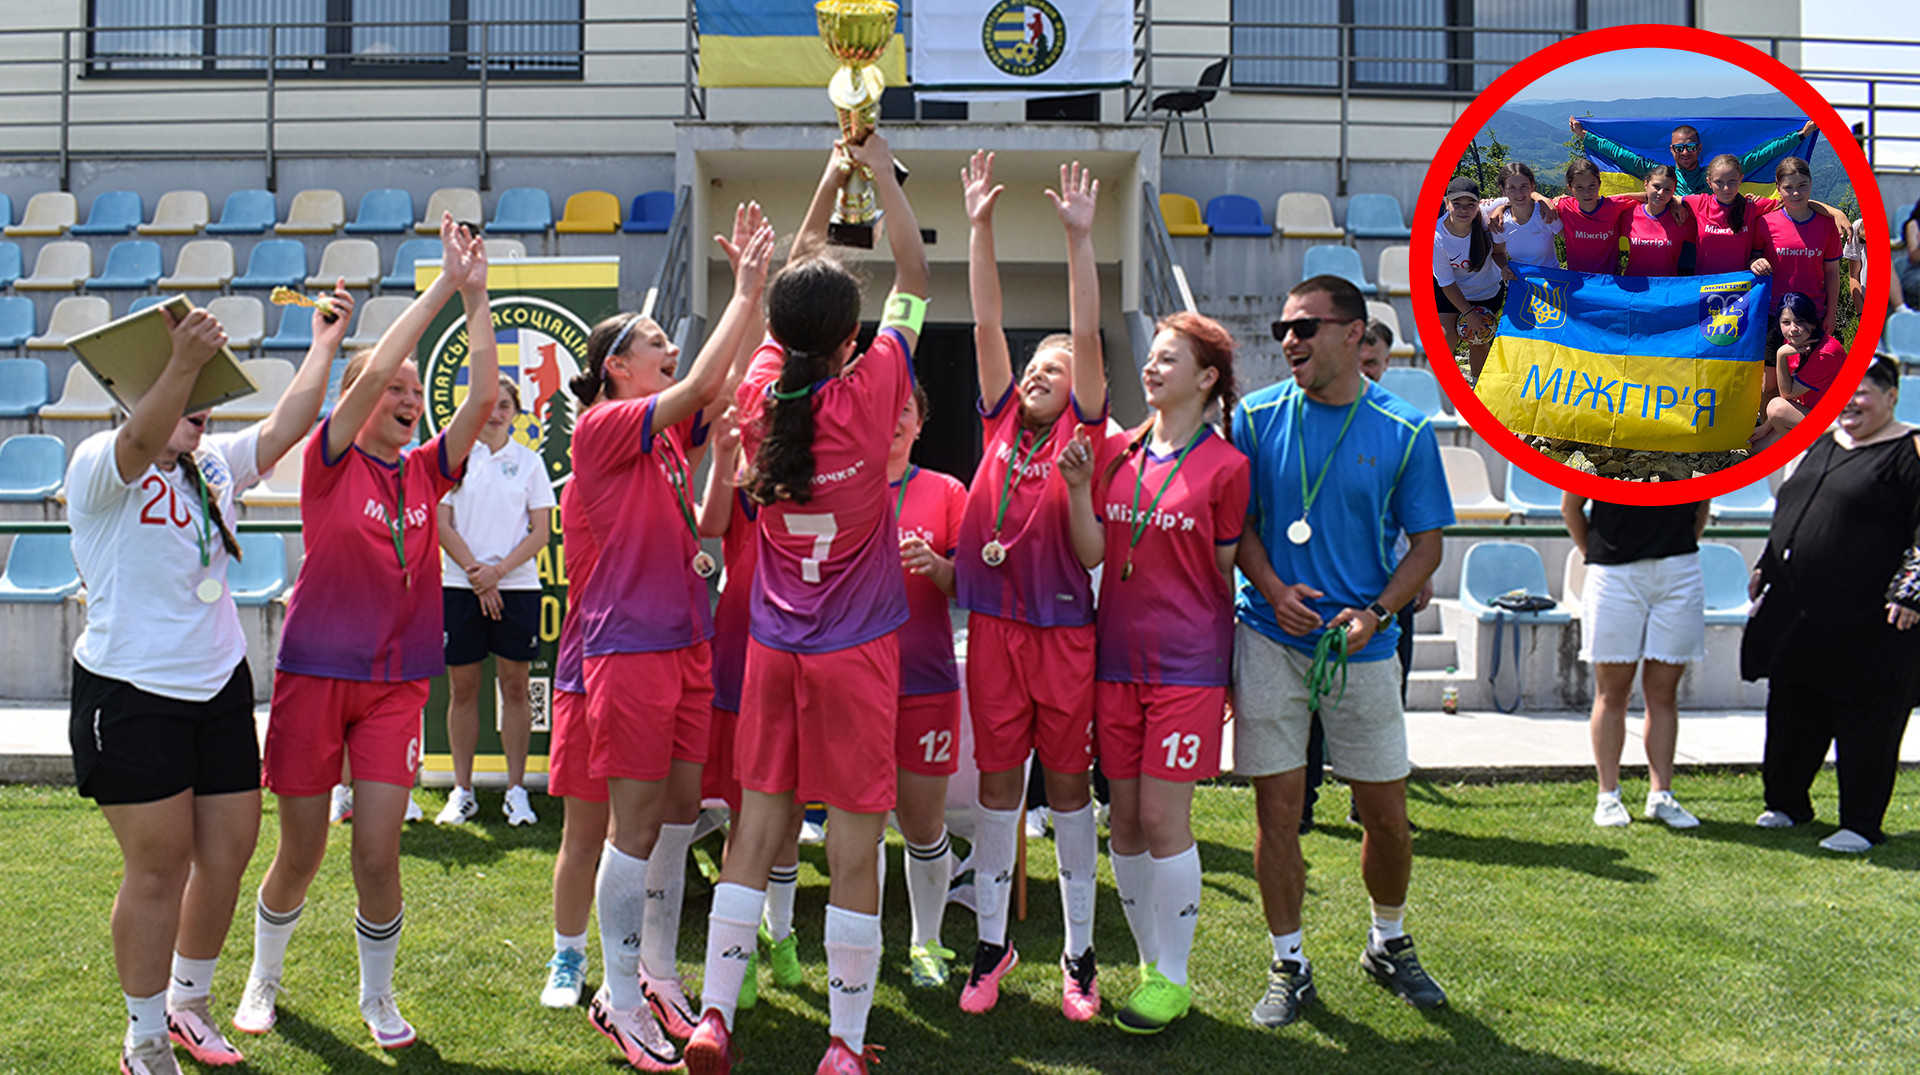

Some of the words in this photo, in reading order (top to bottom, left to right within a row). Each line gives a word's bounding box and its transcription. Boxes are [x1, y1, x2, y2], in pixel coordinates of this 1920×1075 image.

[1520, 364, 1717, 427] МІЖГІР'Я
[782, 513, 838, 582] 7
[919, 730, 951, 763] 12
[1161, 732, 1201, 769] 13
